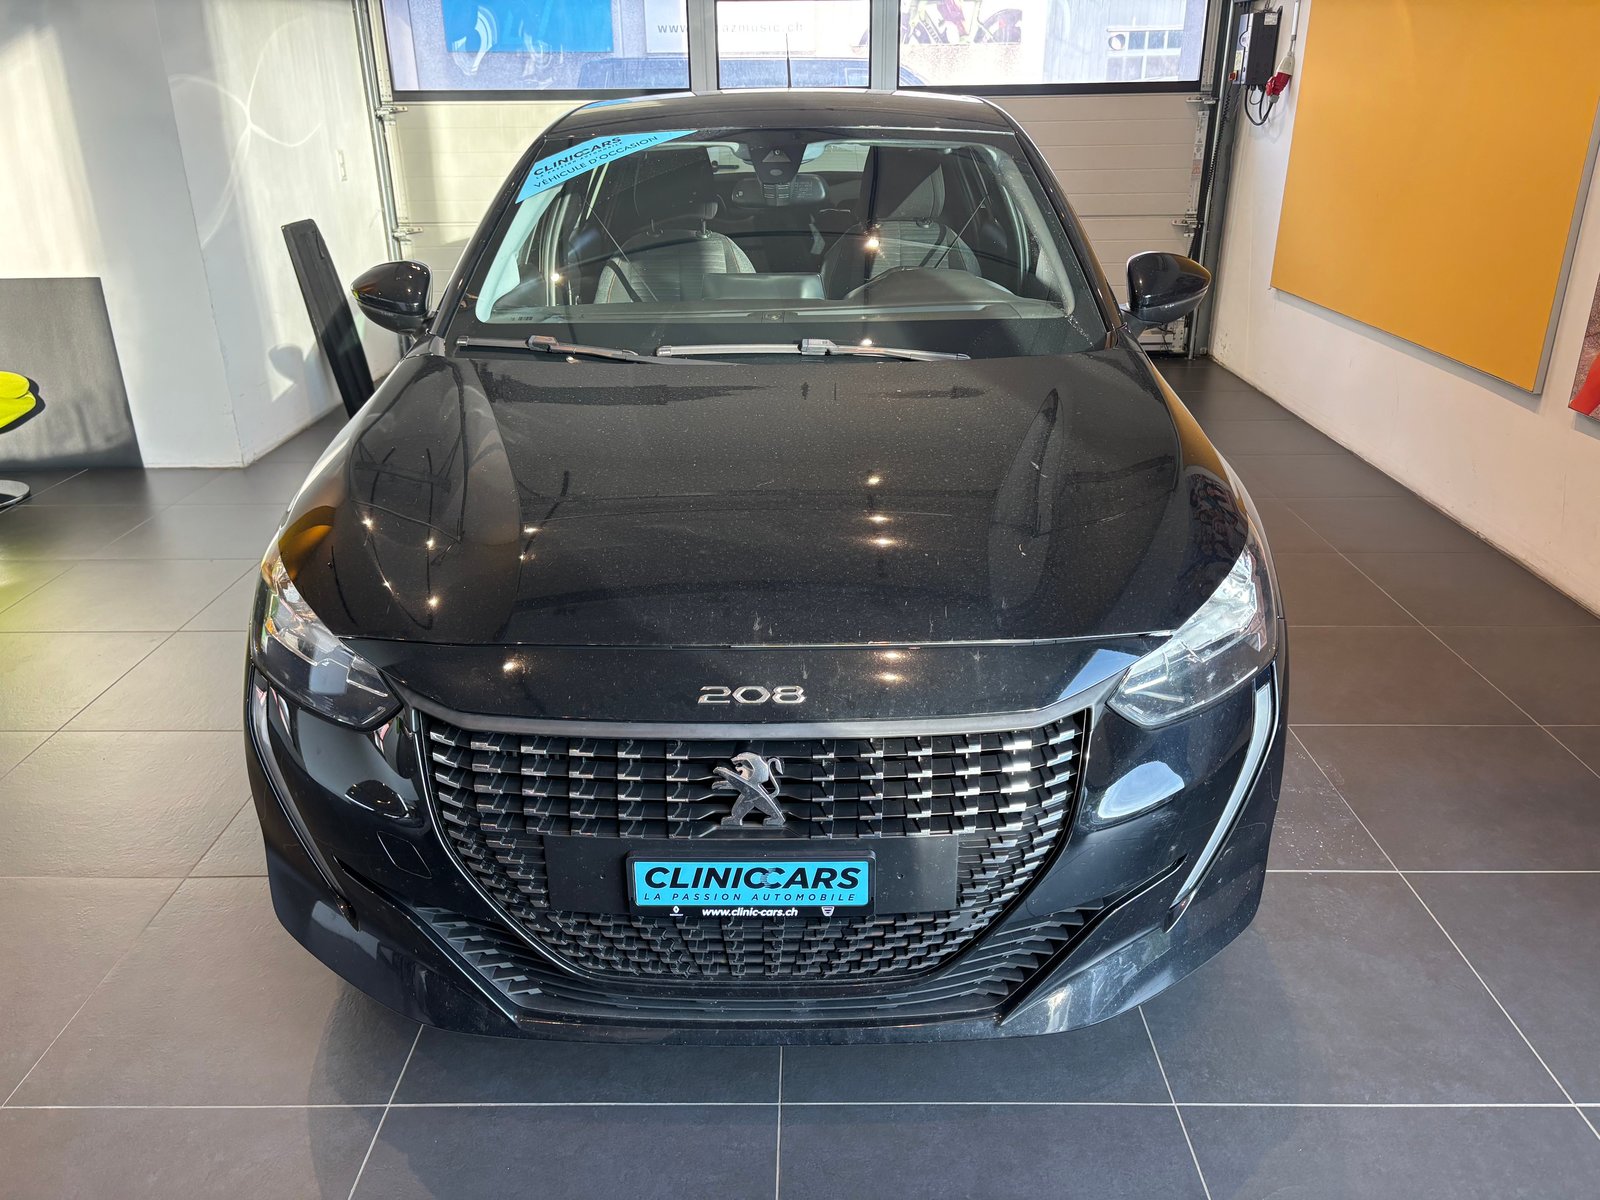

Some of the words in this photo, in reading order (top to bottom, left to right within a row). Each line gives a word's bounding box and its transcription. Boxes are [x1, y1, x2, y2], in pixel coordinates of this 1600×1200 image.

[588, 136, 658, 164] D'OCCASION
[697, 686, 806, 704] 208
[644, 867, 861, 889] CLINICCARS
[644, 893, 661, 902] LA
[672, 893, 741, 902] PASSION
[751, 893, 856, 902] AUTOMOBILE
[702, 907, 799, 917] www.clinic-cars.ch
